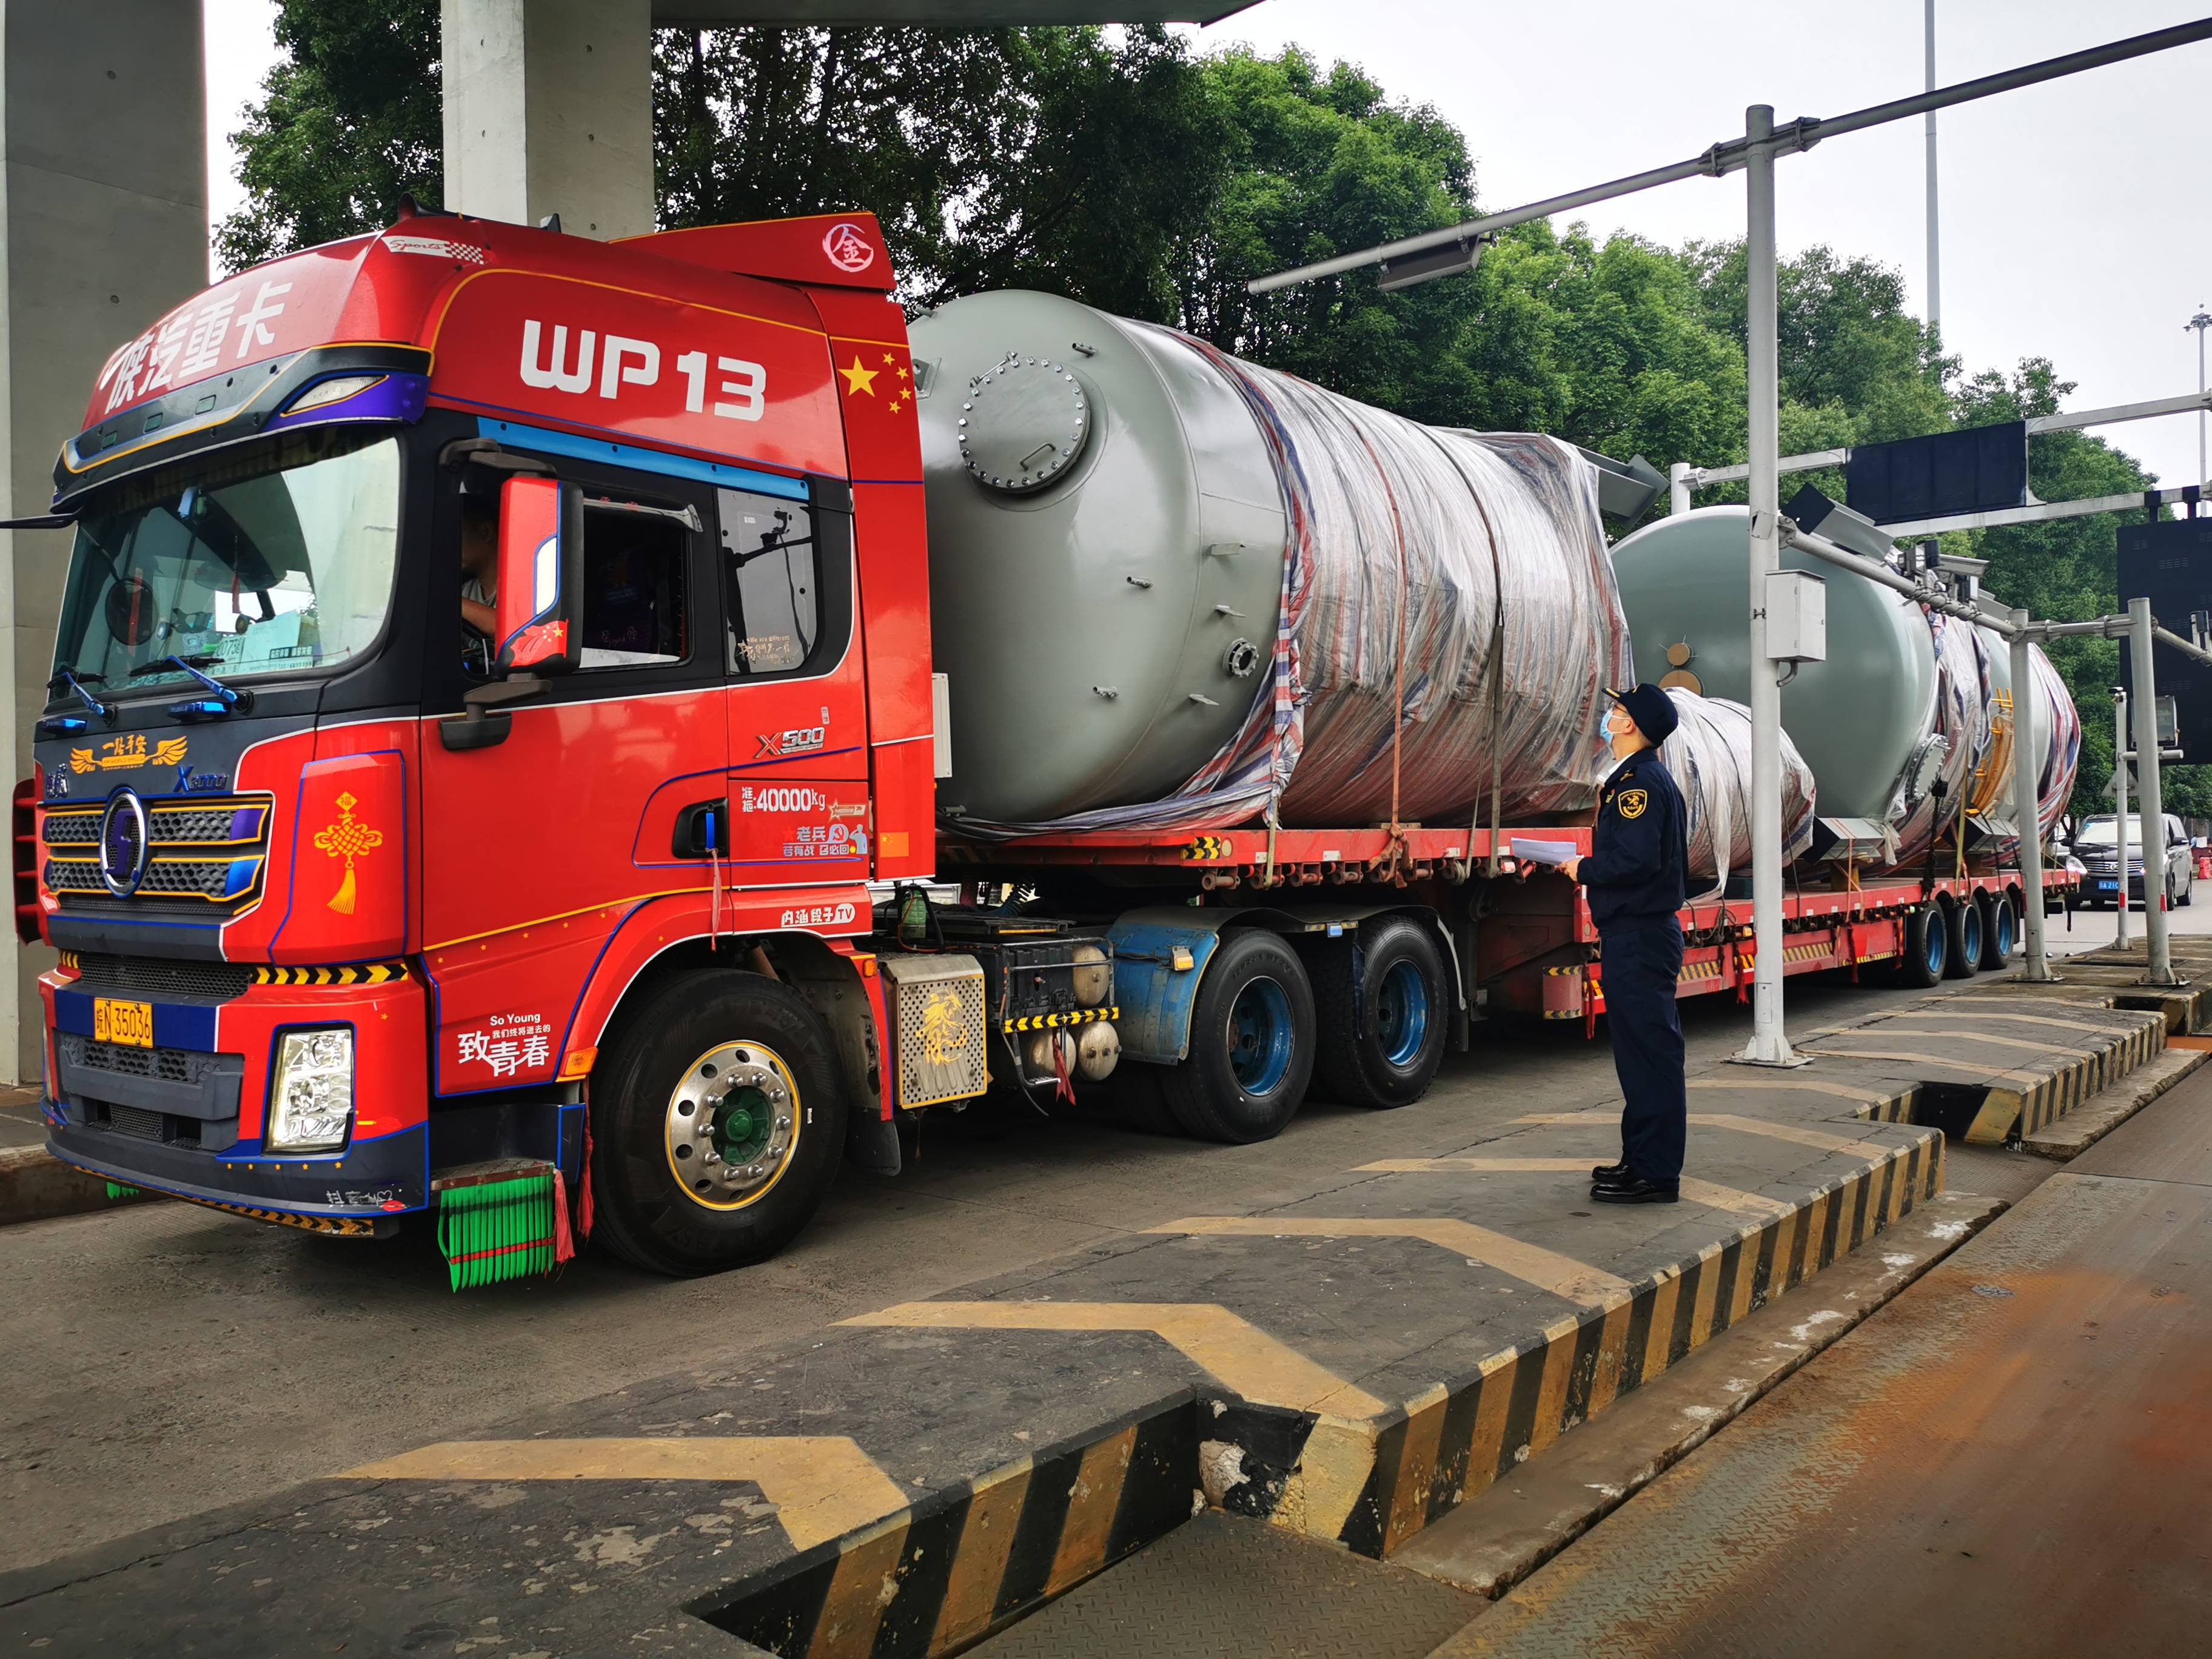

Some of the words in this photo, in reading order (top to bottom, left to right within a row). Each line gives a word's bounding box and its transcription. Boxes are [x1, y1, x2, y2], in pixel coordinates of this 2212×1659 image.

[390, 240, 444, 250] Sports
[833, 226, 872, 263] 金
[796, 826, 826, 842] 老兵
[783, 845, 814, 856] 若有战
[819, 844, 850, 856] 召必回
[490, 1016, 504, 1025] So
[507, 1014, 540, 1024] Young
[492, 1024, 551, 1039] 我们终将逝去的
[458, 1031, 550, 1077] 致青春
